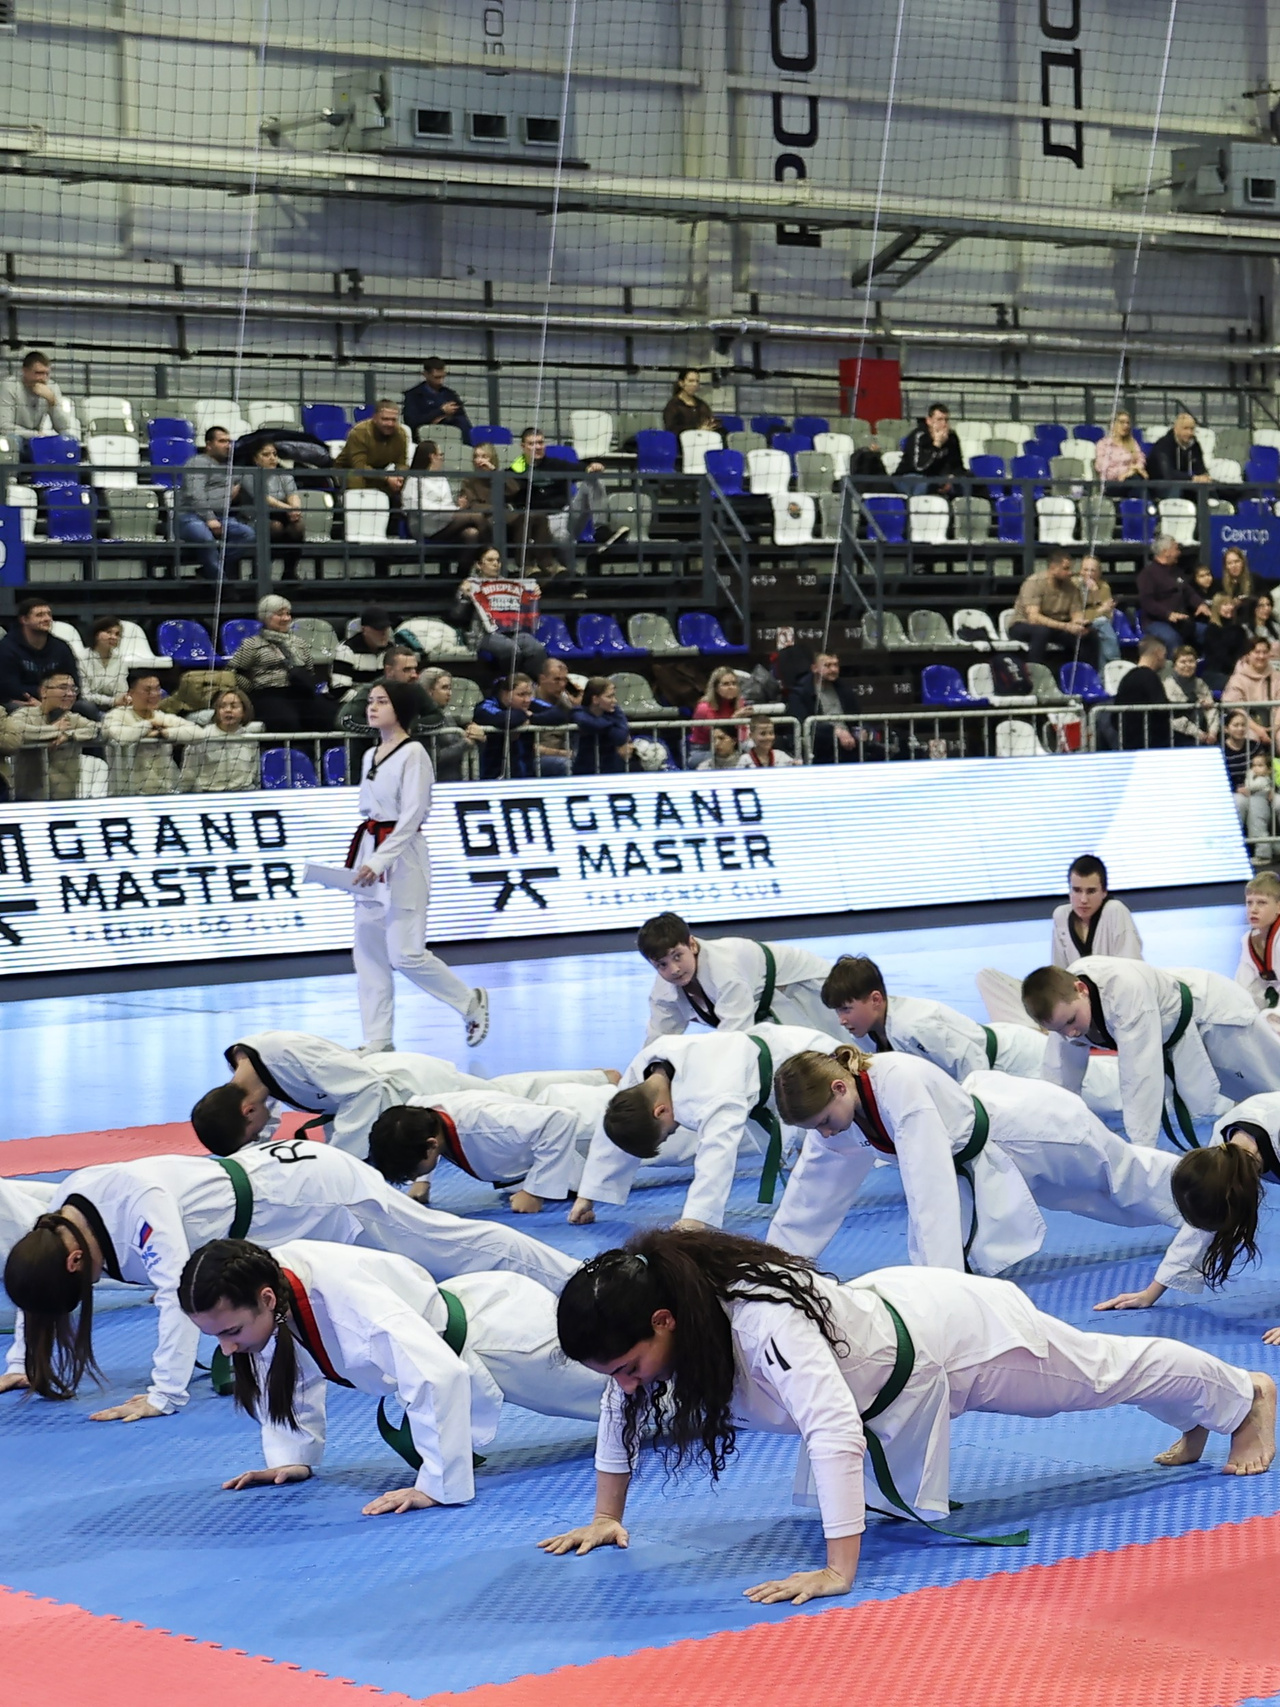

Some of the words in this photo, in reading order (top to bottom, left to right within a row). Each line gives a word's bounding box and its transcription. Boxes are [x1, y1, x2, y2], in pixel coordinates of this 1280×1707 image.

[1221, 525, 1270, 545] Сектор
[49, 810, 286, 861] GRAND
[454, 797, 554, 858] GM
[566, 788, 763, 832] GRAND
[577, 834, 776, 880] MASTER
[61, 862, 300, 913] MASTER
